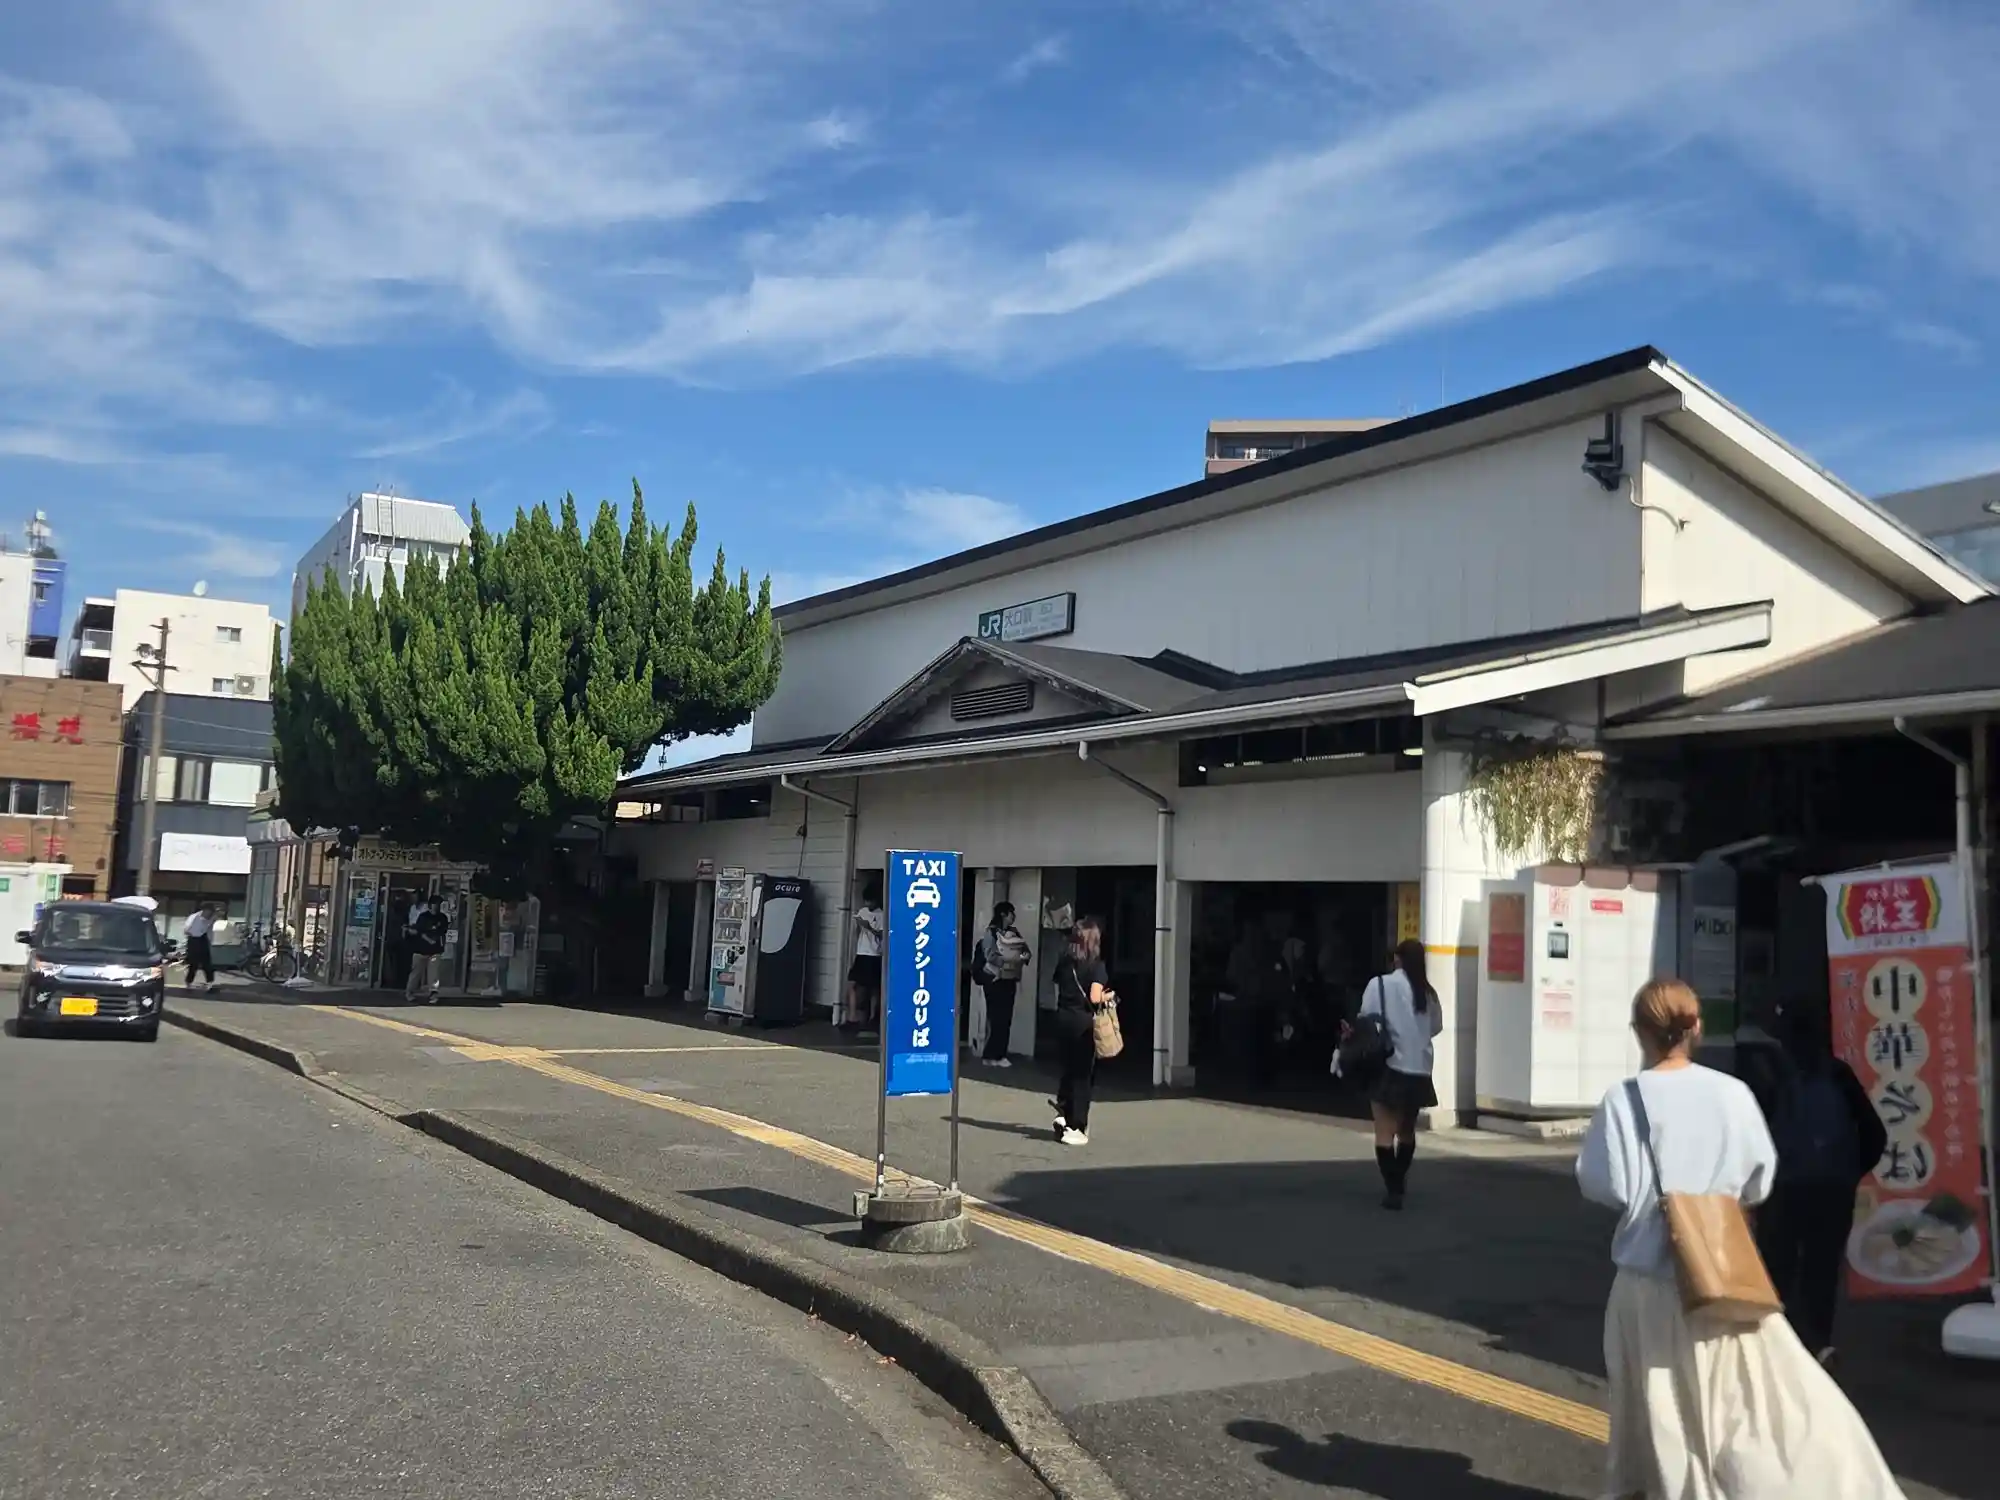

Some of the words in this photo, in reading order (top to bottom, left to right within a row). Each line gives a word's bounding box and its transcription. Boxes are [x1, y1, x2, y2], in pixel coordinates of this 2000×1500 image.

[981, 614, 1001, 637] JR
[902, 859, 946, 876] TAXI
[774, 883, 801, 893] acure
[912, 912, 931, 1048] タクシーのりば
